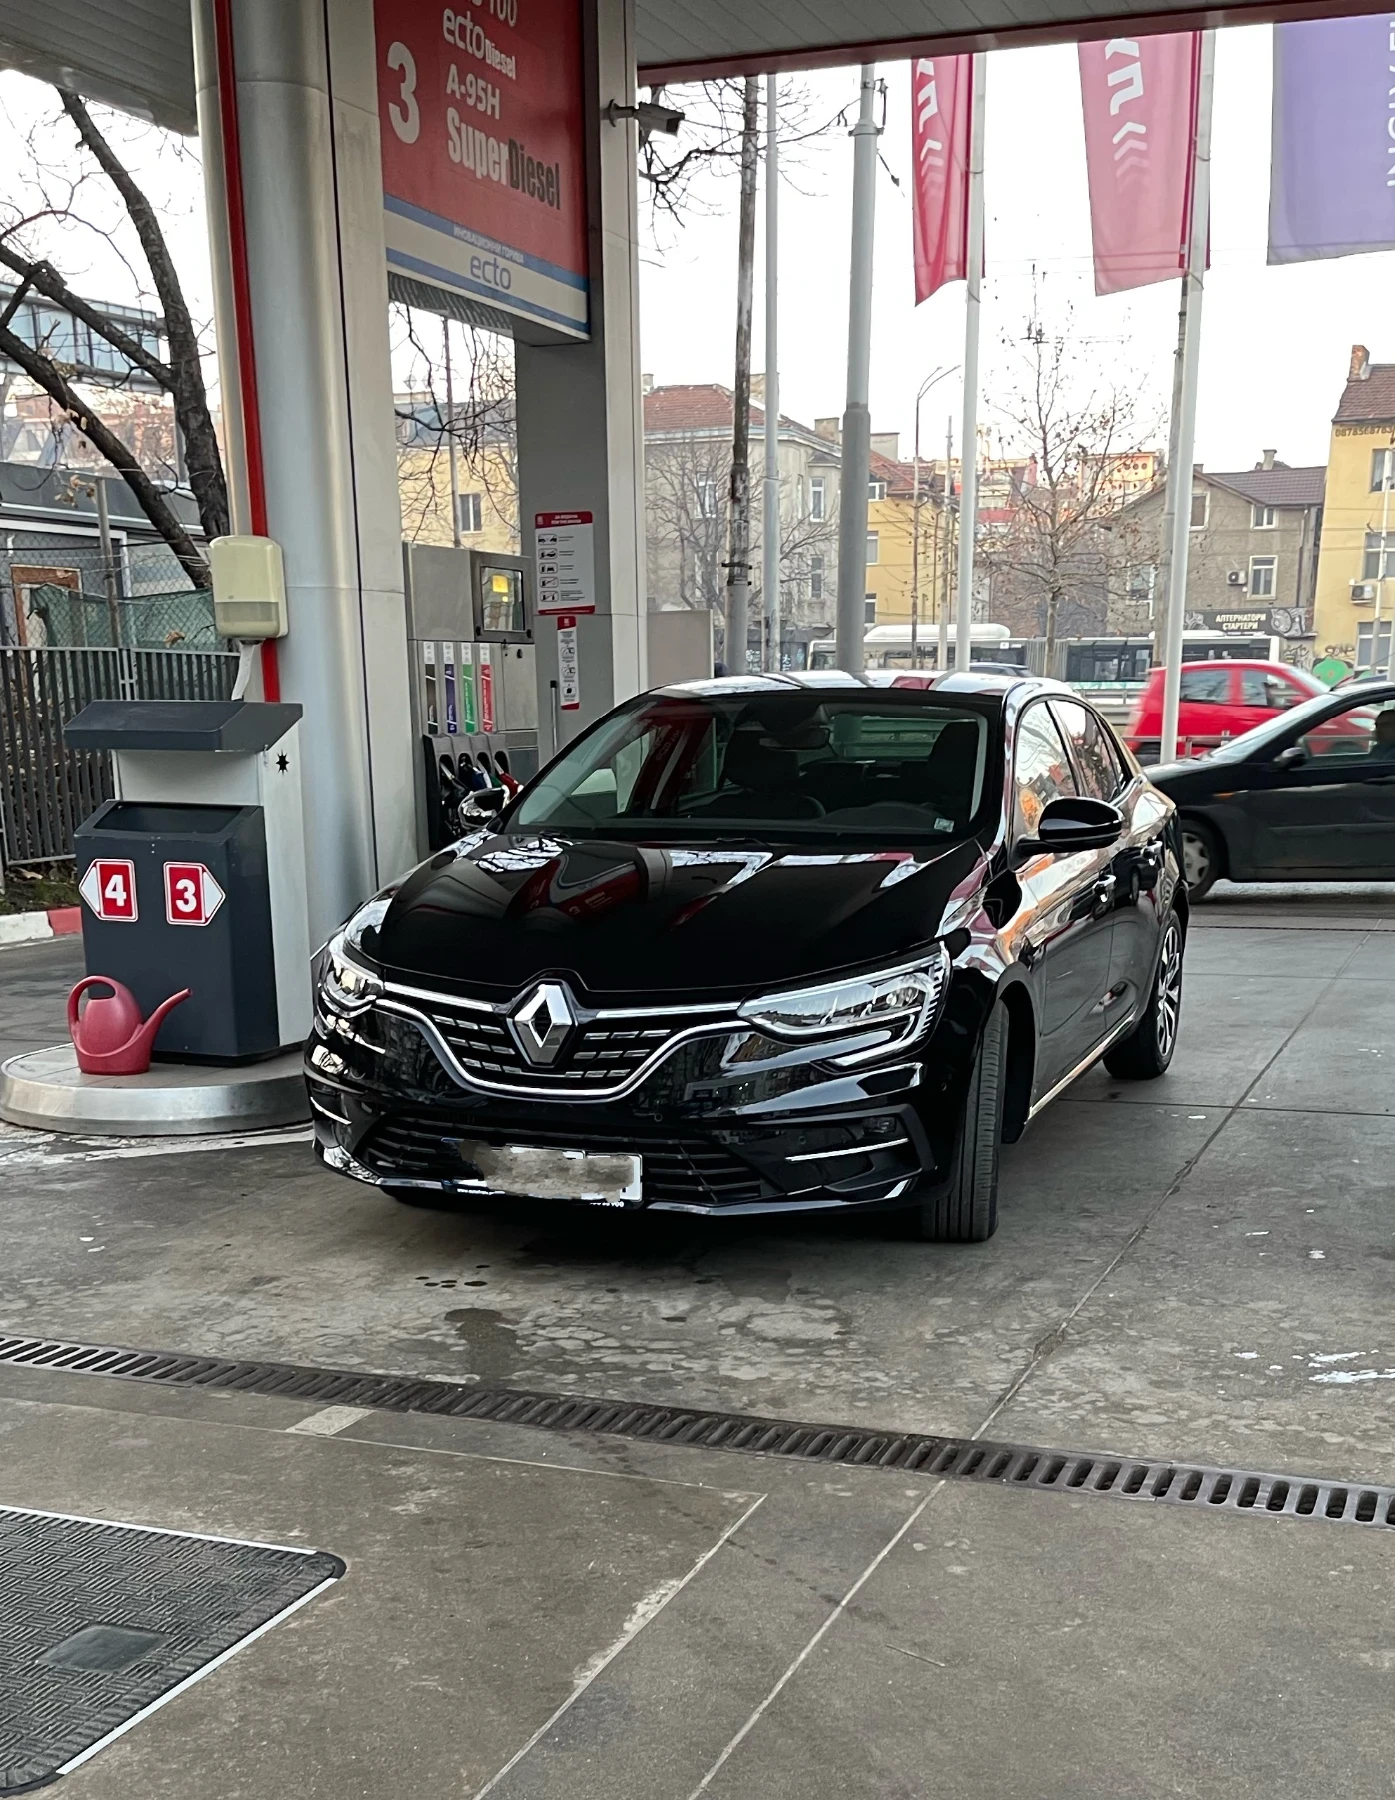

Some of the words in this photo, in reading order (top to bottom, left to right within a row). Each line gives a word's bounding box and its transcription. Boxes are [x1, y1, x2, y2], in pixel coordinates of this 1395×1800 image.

[387, 41, 420, 144] 3
[446, 63, 500, 120] A-95H
[470, 255, 512, 290] ecto
[1222, 622, 1259, 631] СТАРТЕРИ
[104, 874, 127, 907] 4
[175, 878, 197, 913] 3
